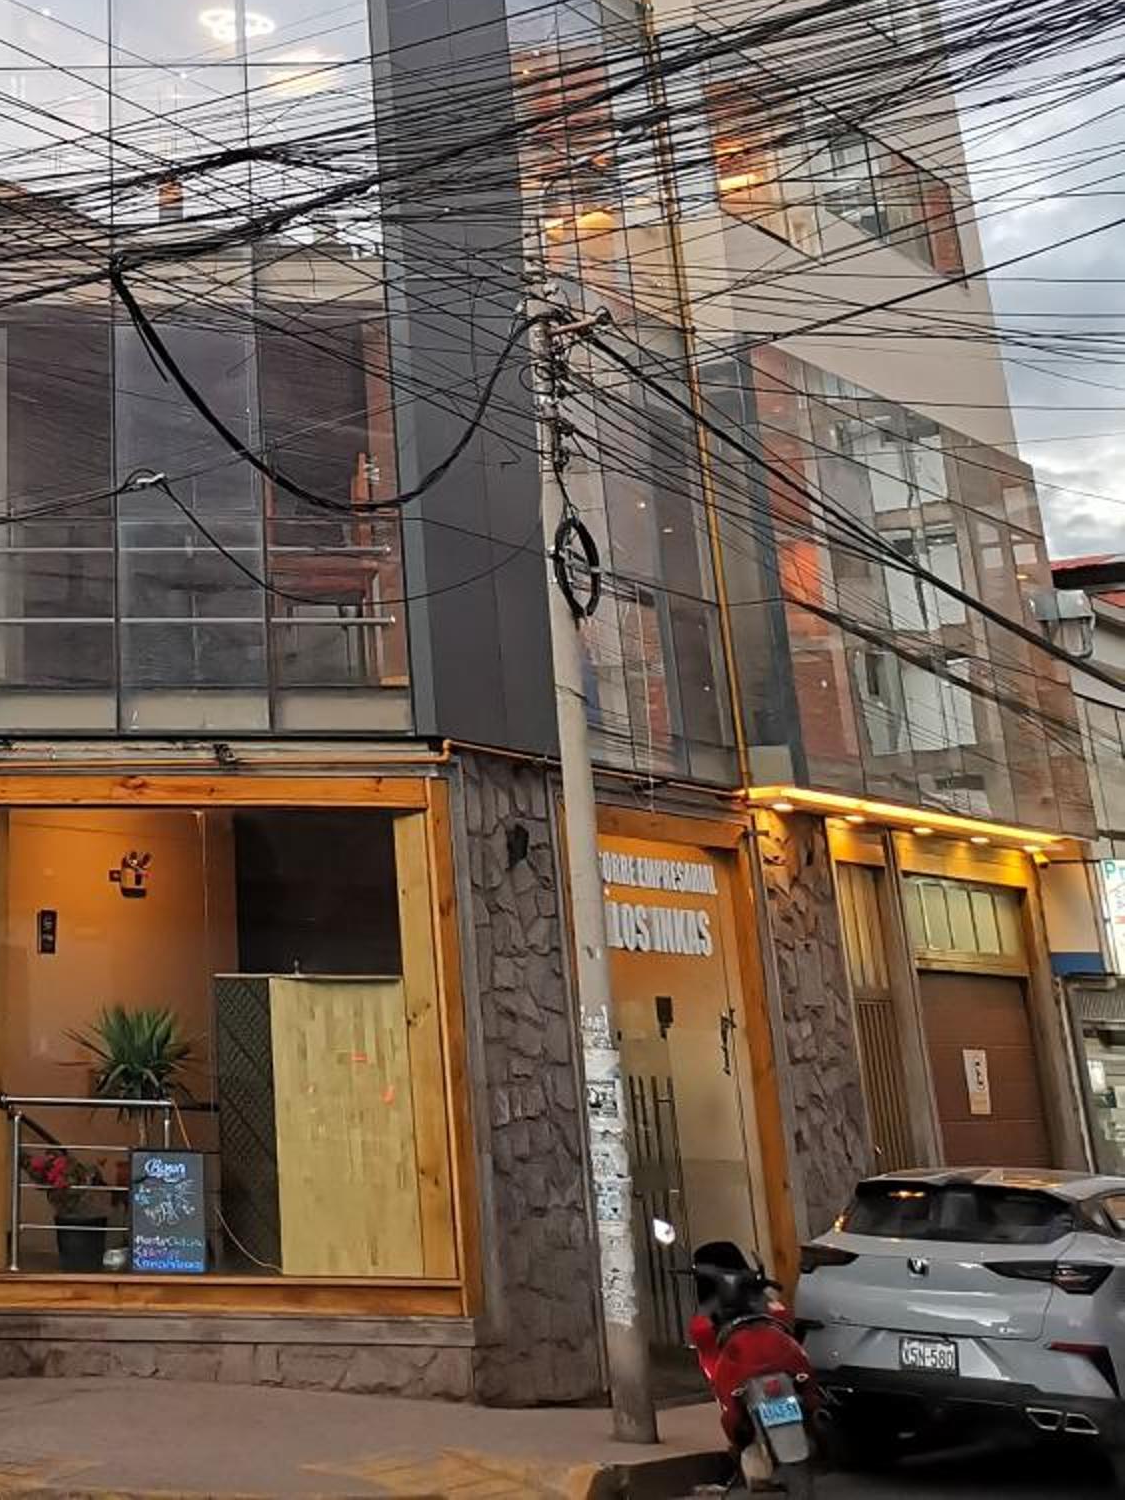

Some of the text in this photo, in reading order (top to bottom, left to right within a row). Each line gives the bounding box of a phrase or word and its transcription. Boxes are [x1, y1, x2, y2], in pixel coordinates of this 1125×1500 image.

[637, 857, 719, 895] EMPRESARIAL
[605, 901, 714, 958] LOS INKAS
